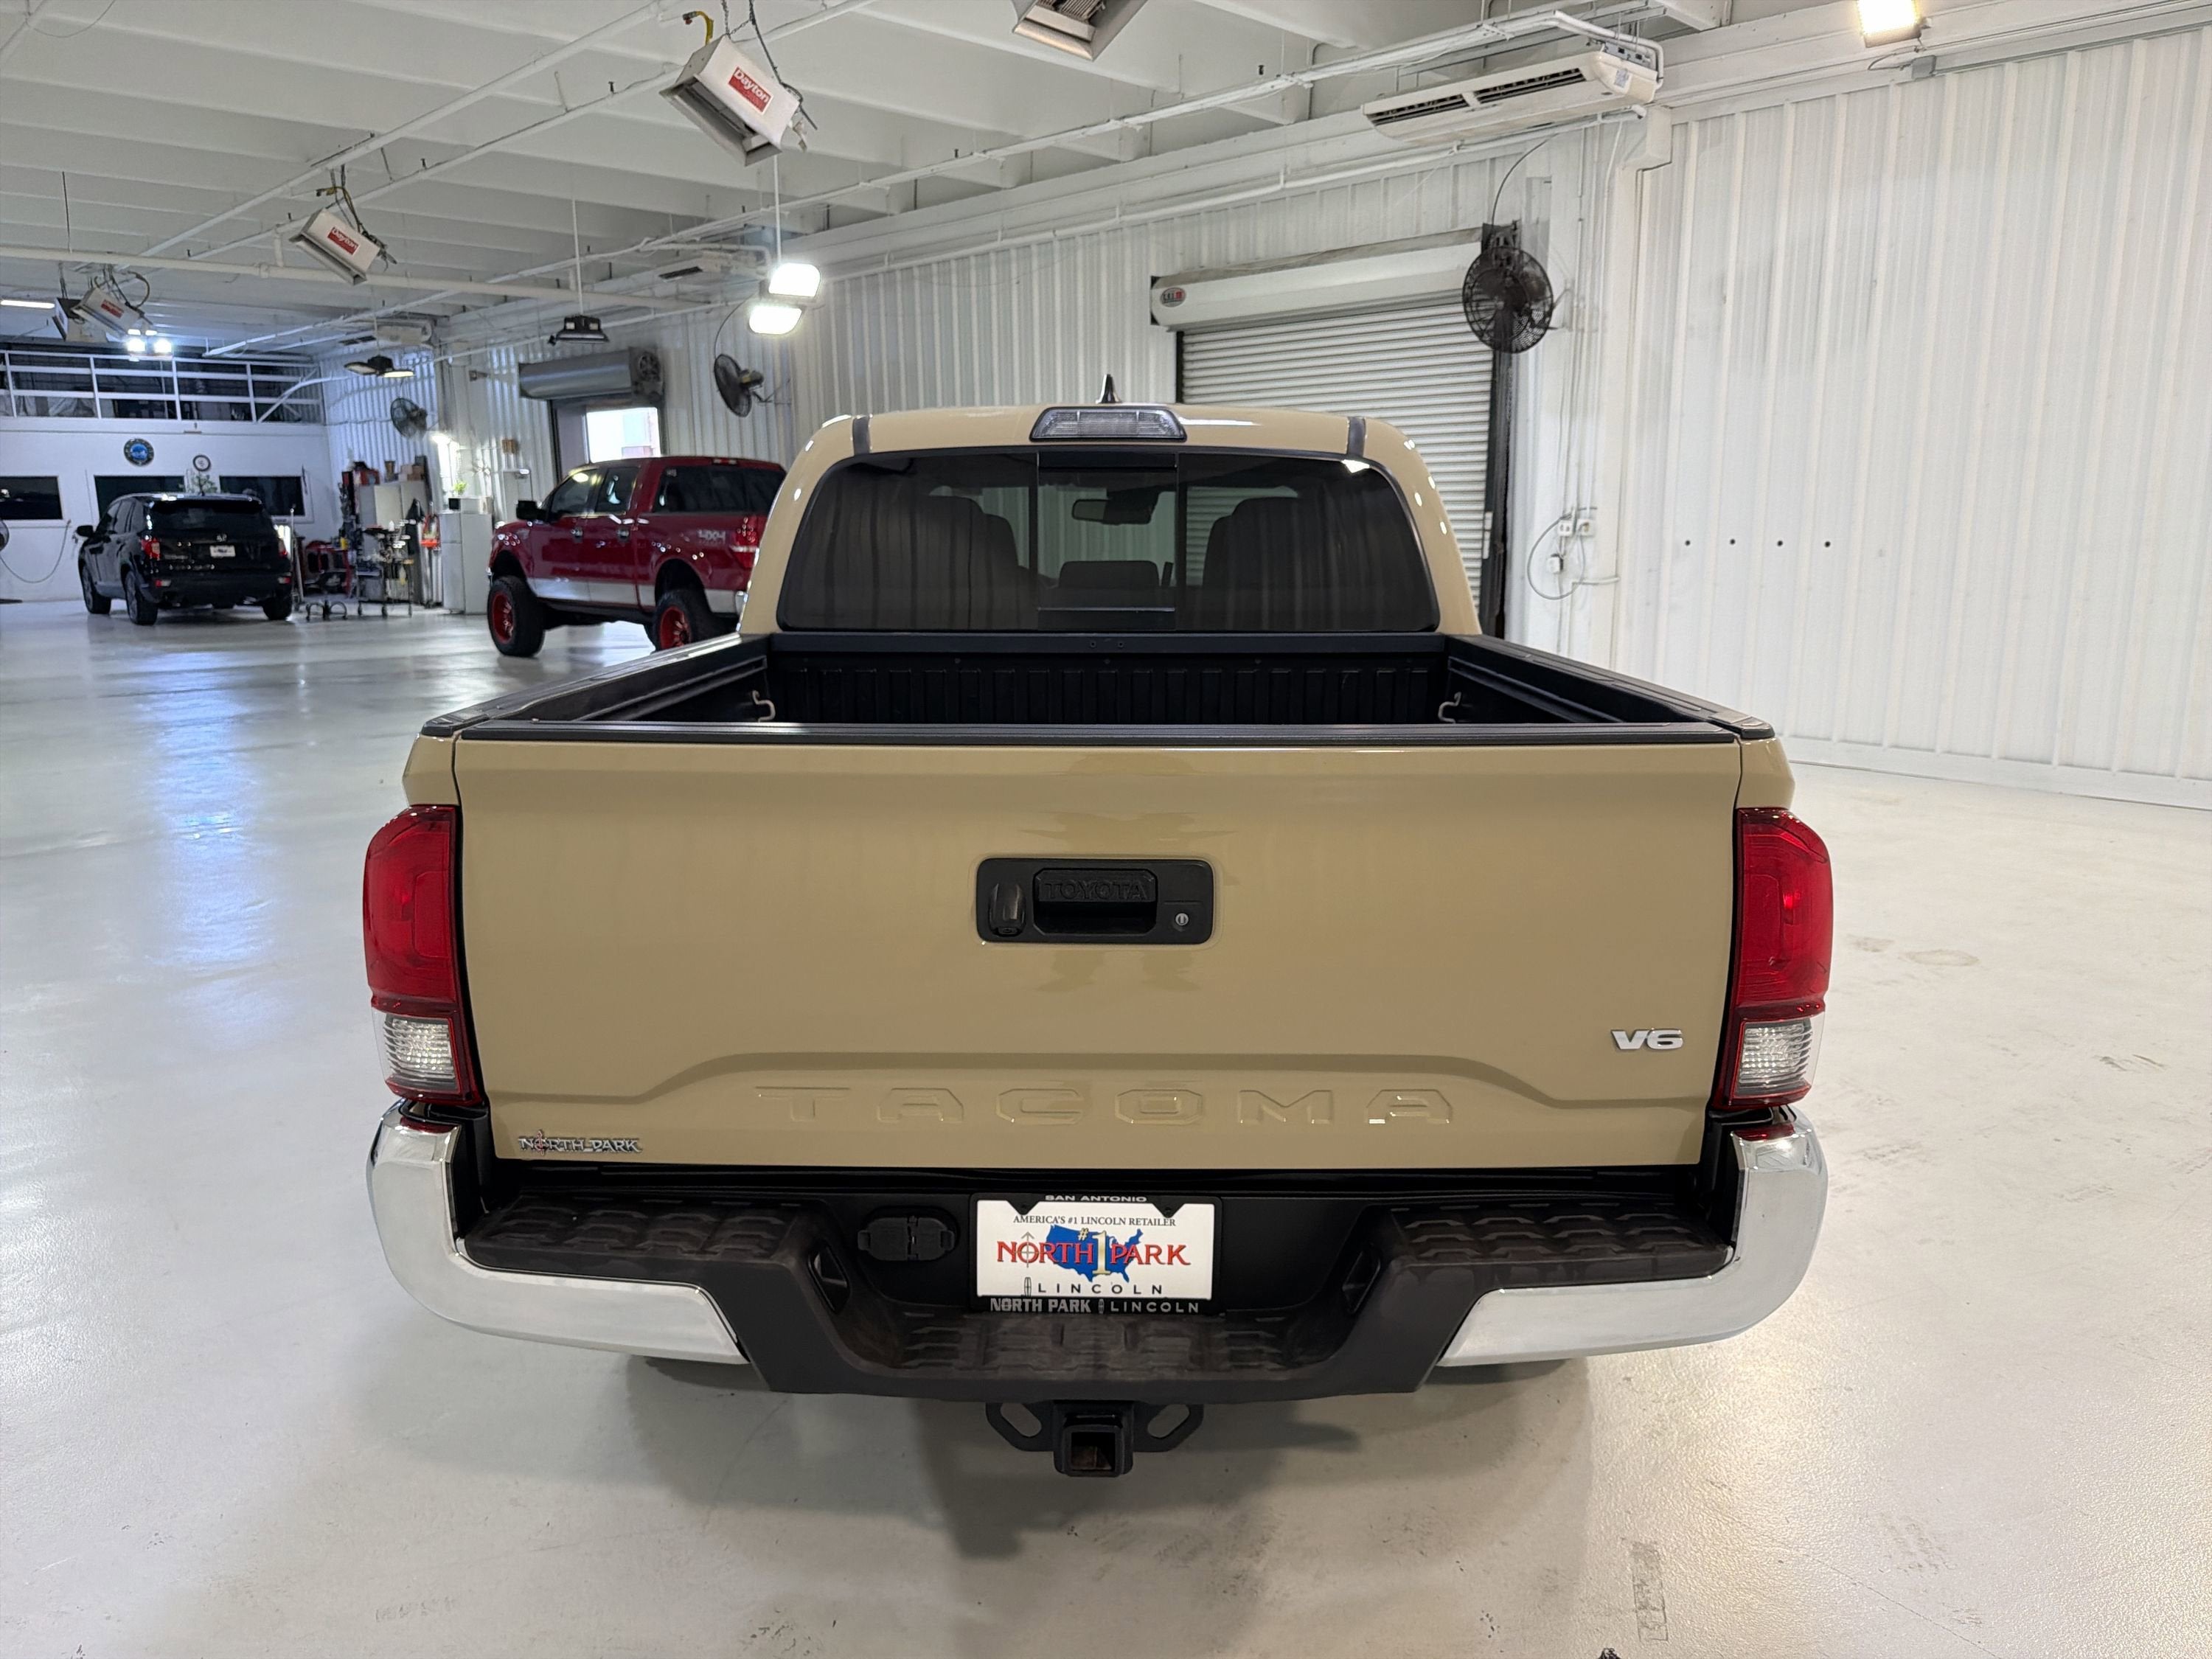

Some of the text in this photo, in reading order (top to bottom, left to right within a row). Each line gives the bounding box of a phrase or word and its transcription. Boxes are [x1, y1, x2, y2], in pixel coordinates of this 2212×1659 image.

[733, 69, 769, 103] Dayton
[1045, 880, 1149, 900] TOYOTA
[1611, 1029, 1684, 1050] V6
[755, 1086, 1453, 1125] TACOMA
[518, 1137, 642, 1153] NORTH PARK
[1013, 1215, 1065, 1224] AMERICA'S
[1081, 1217, 1126, 1225] LINCOLN
[1129, 1217, 1176, 1227] RETAILER
[997, 1241, 1094, 1264] NORTH
[1110, 1243, 1192, 1266] PARK
[1038, 1283, 1162, 1295] LINCOLN
[990, 1298, 1199, 1313] NORTH PARK LINCOLN
